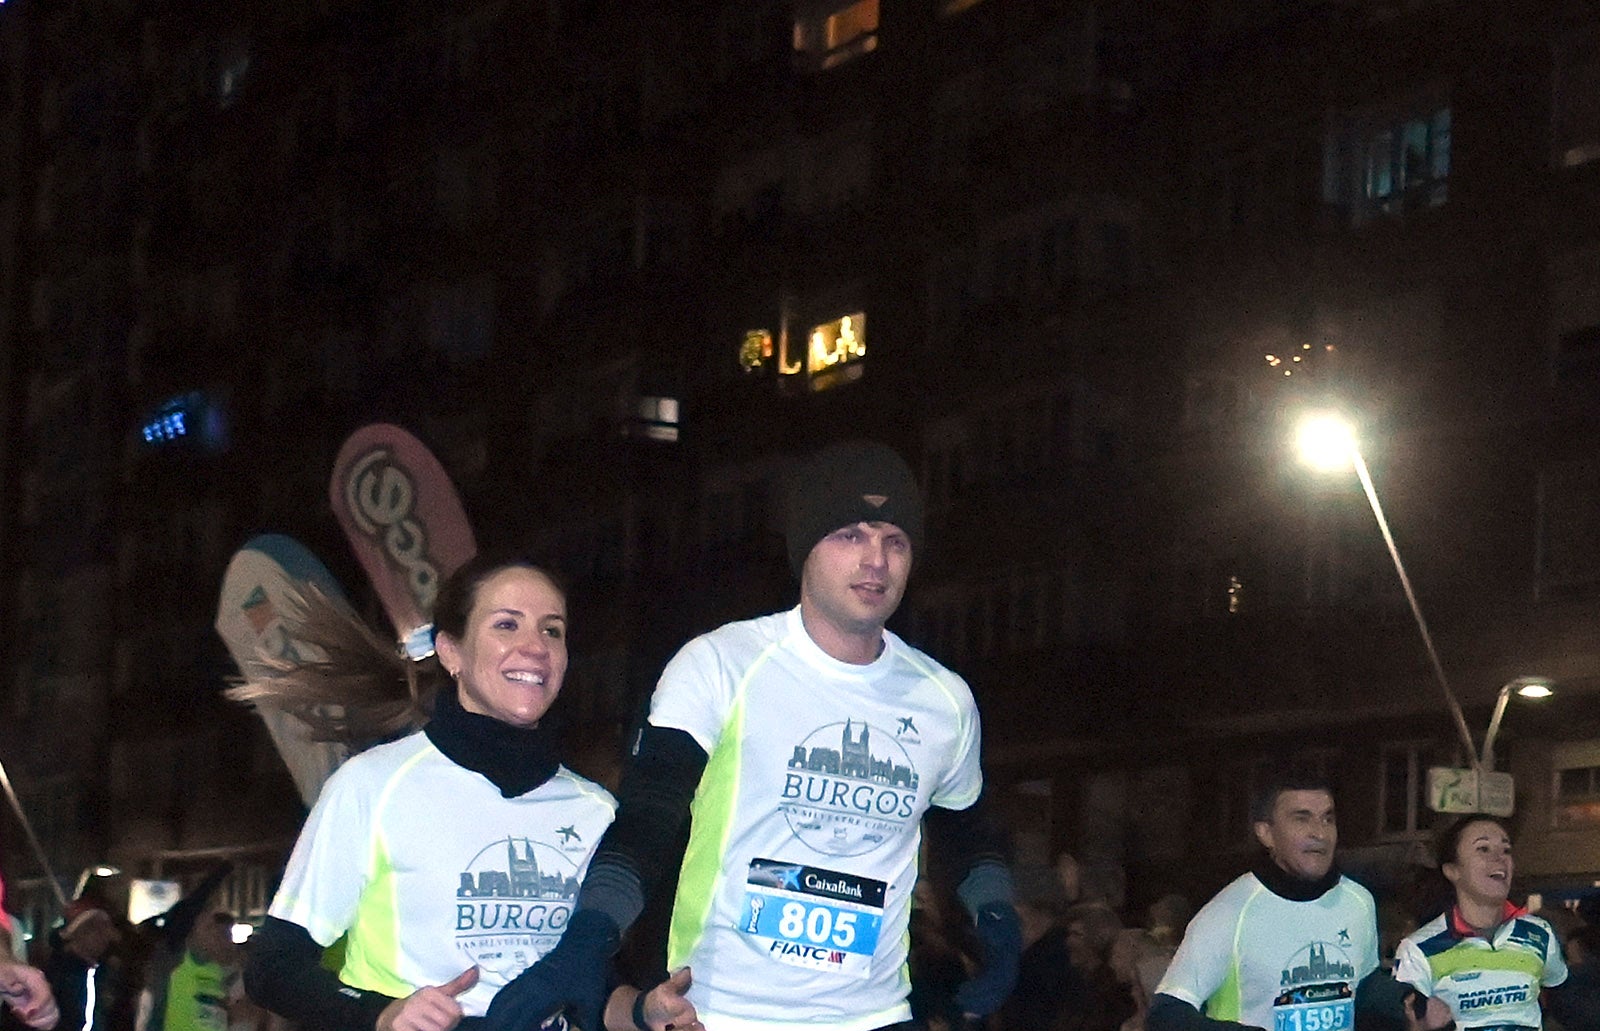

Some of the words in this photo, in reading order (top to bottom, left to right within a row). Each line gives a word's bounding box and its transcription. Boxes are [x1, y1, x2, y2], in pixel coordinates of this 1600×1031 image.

[780, 773, 917, 819] BURGOS
[804, 873, 863, 899] CaixaBank
[455, 903, 570, 932] BURGO
[778, 901, 858, 948] 805
[769, 940, 828, 961] FIATC
[1289, 1005, 1345, 1031] 1595
